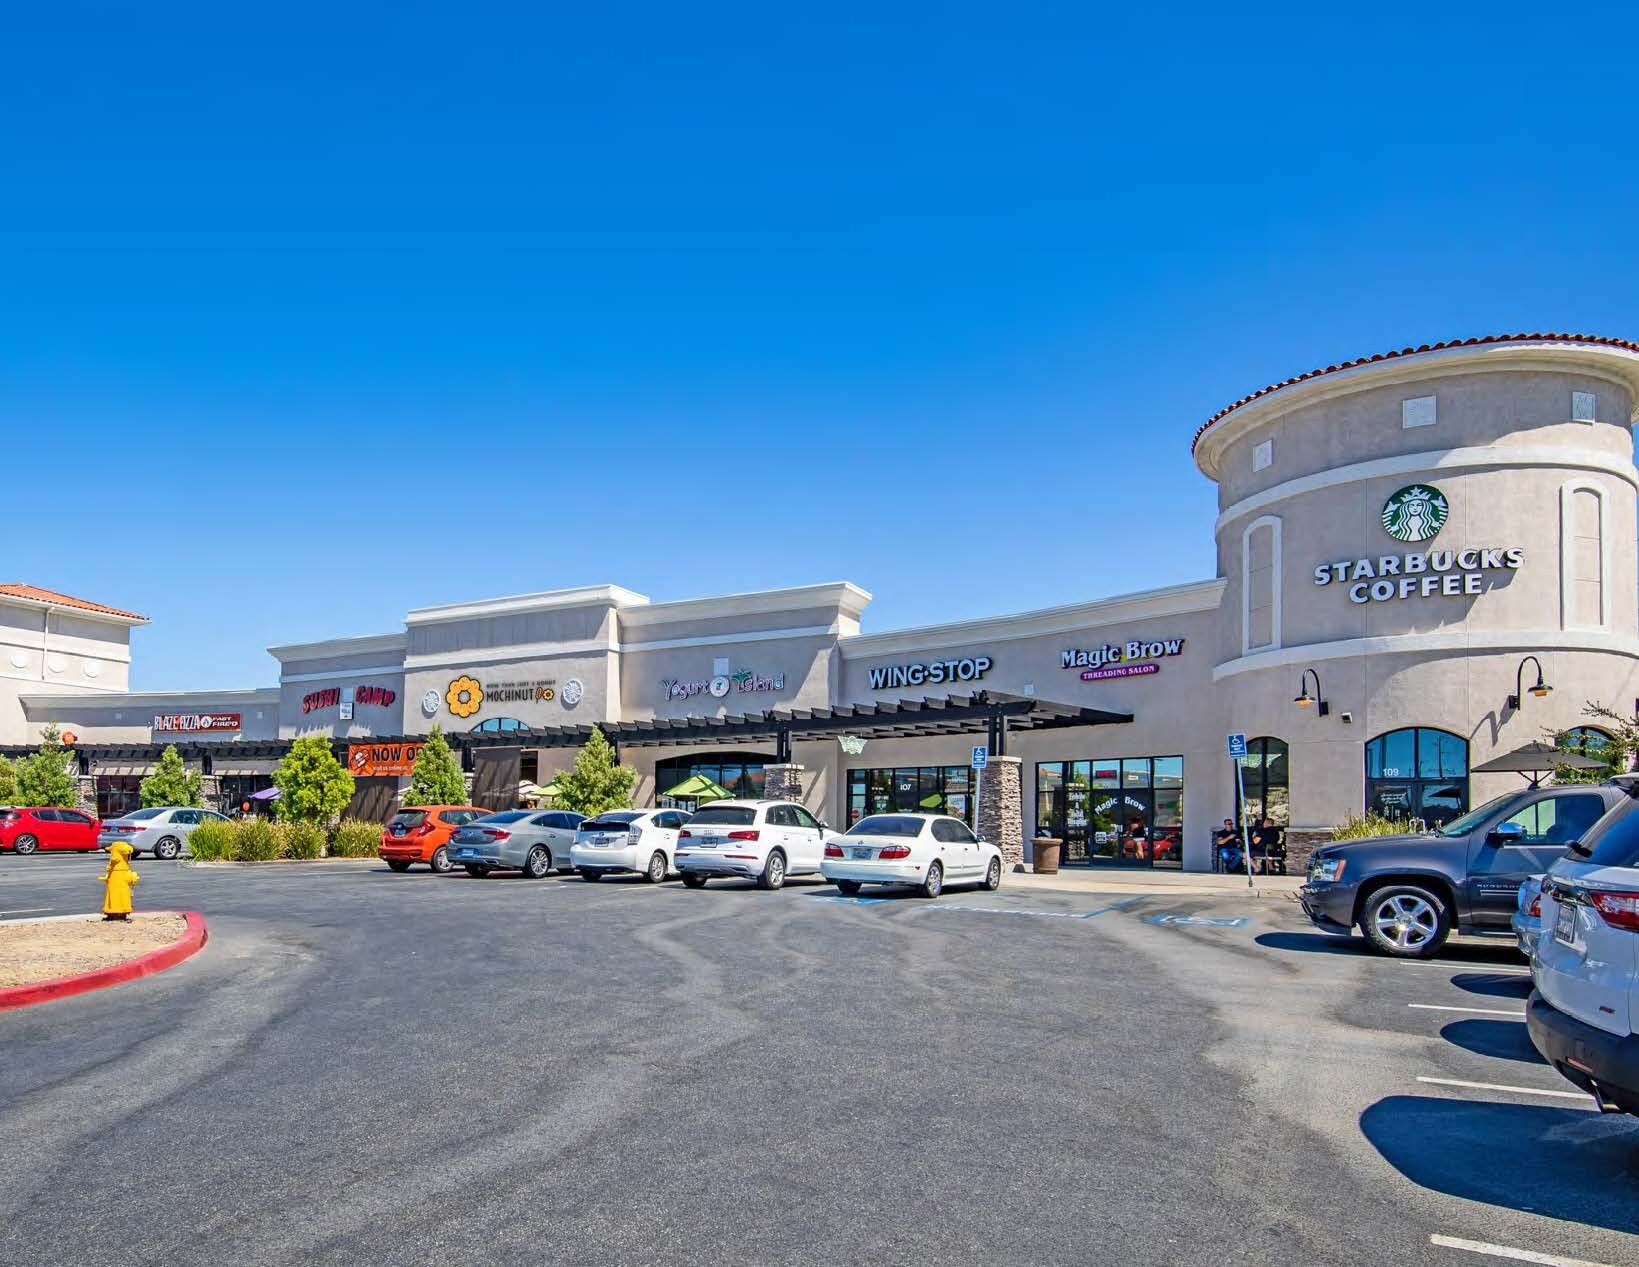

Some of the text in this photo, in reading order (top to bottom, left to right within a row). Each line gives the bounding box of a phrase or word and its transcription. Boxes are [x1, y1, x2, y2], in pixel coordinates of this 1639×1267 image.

[1314, 547, 1524, 586] STARBUCKS
[1350, 573, 1484, 604] COFFEE
[1061, 639, 1184, 670] Magic Brow
[1083, 665, 1155, 680] THREADING SALON
[663, 671, 785, 701] Yogurt Island
[303, 685, 396, 714] SUSHI CAMP
[486, 688, 534, 703] MOCHINUT
[154, 714, 200, 730] BLAZE PIZZA
[372, 747, 402, 762] NOW
[1383, 768, 1400, 776] 109
[900, 783, 912, 791] 107
[1094, 795, 1146, 815] Magic Brow
